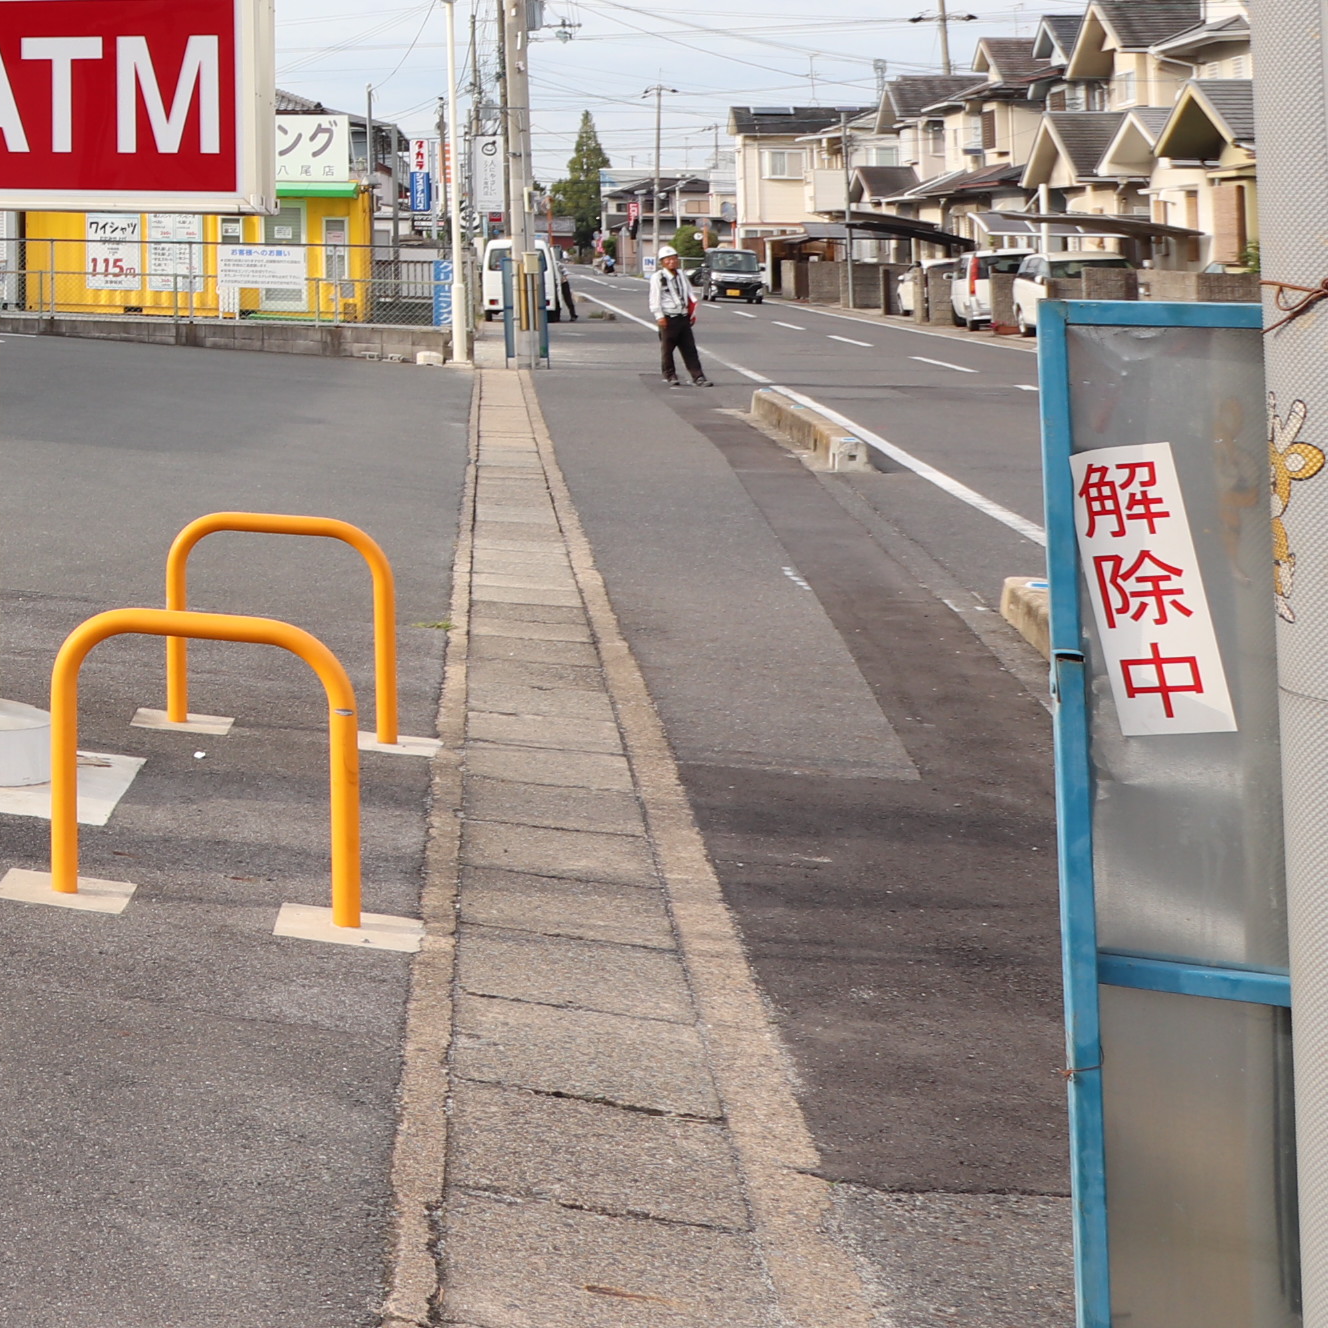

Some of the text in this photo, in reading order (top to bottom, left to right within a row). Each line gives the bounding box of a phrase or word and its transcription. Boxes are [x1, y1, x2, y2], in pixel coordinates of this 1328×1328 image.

[415, 140, 425, 170] タカラ
[277, 165, 335, 176] 八尾店
[89, 221, 138, 235] ワイシャツ
[230, 248, 291, 257] お客様へのお願い
[1077, 460, 1204, 719] 解除中
